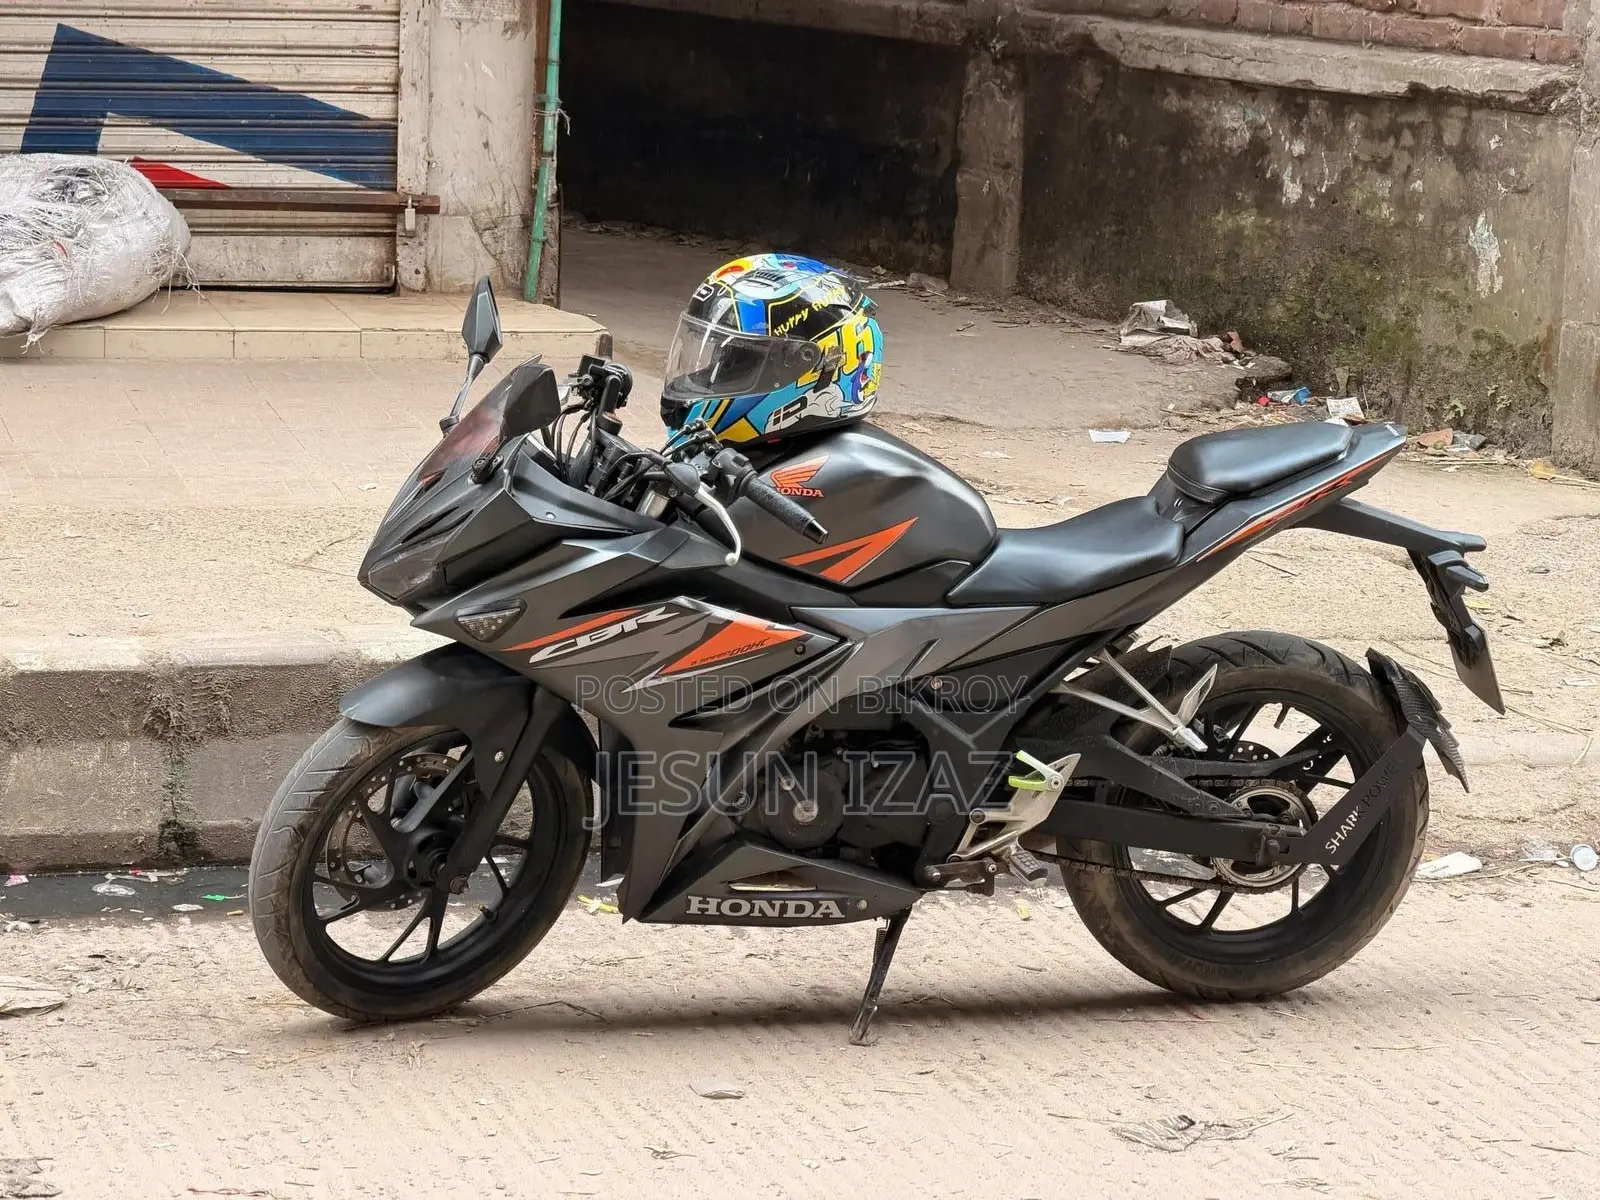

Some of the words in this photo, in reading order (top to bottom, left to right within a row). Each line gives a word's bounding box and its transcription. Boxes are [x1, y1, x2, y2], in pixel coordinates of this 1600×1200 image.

[529, 606, 680, 664] CBR
[1325, 805, 1366, 855] SHARK
[1361, 755, 1402, 808] POWE
[686, 895, 845, 918] HONDA
